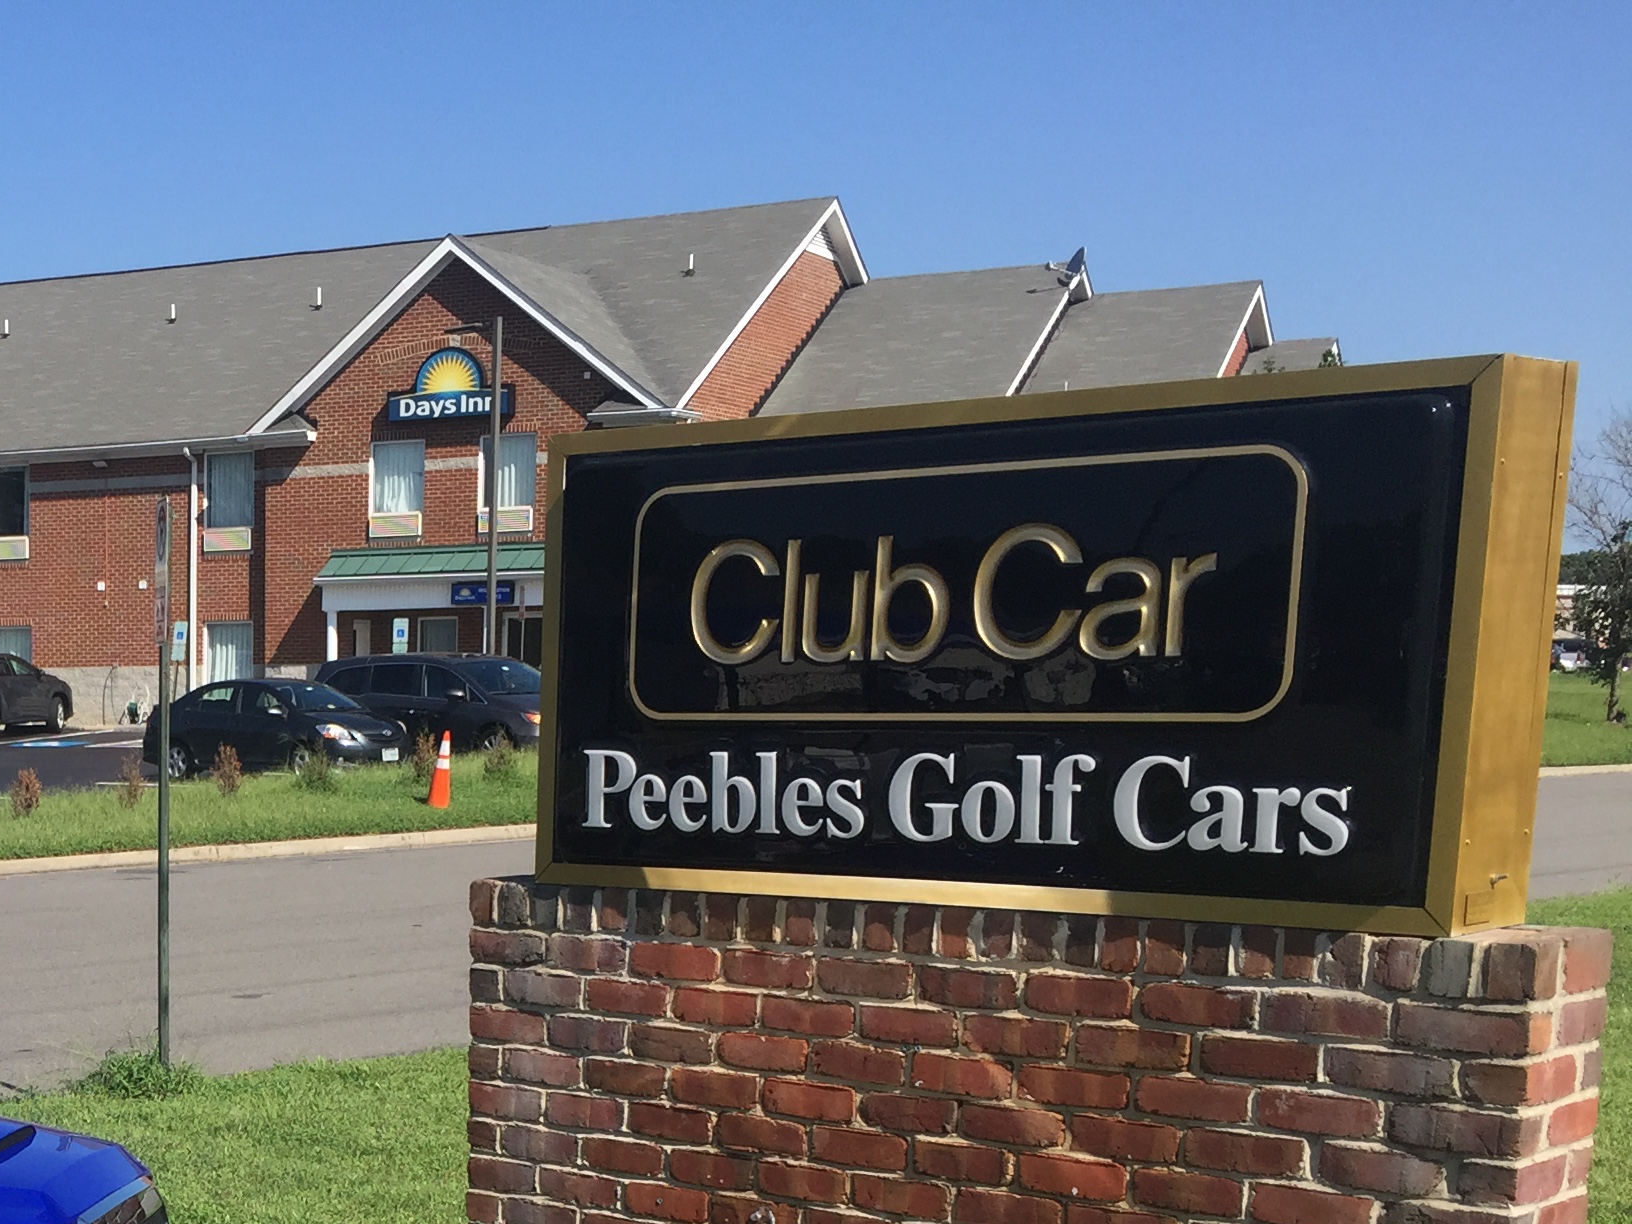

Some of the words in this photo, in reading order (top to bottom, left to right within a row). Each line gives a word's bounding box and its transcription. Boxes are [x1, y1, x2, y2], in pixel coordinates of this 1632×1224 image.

[399, 398, 456, 418] Days
[690, 535, 950, 665] Club
[973, 522, 1218, 662] Car
[581, 749, 866, 839] Peebles
[888, 752, 1096, 846] Golf
[1113, 755, 1352, 857] Cars
